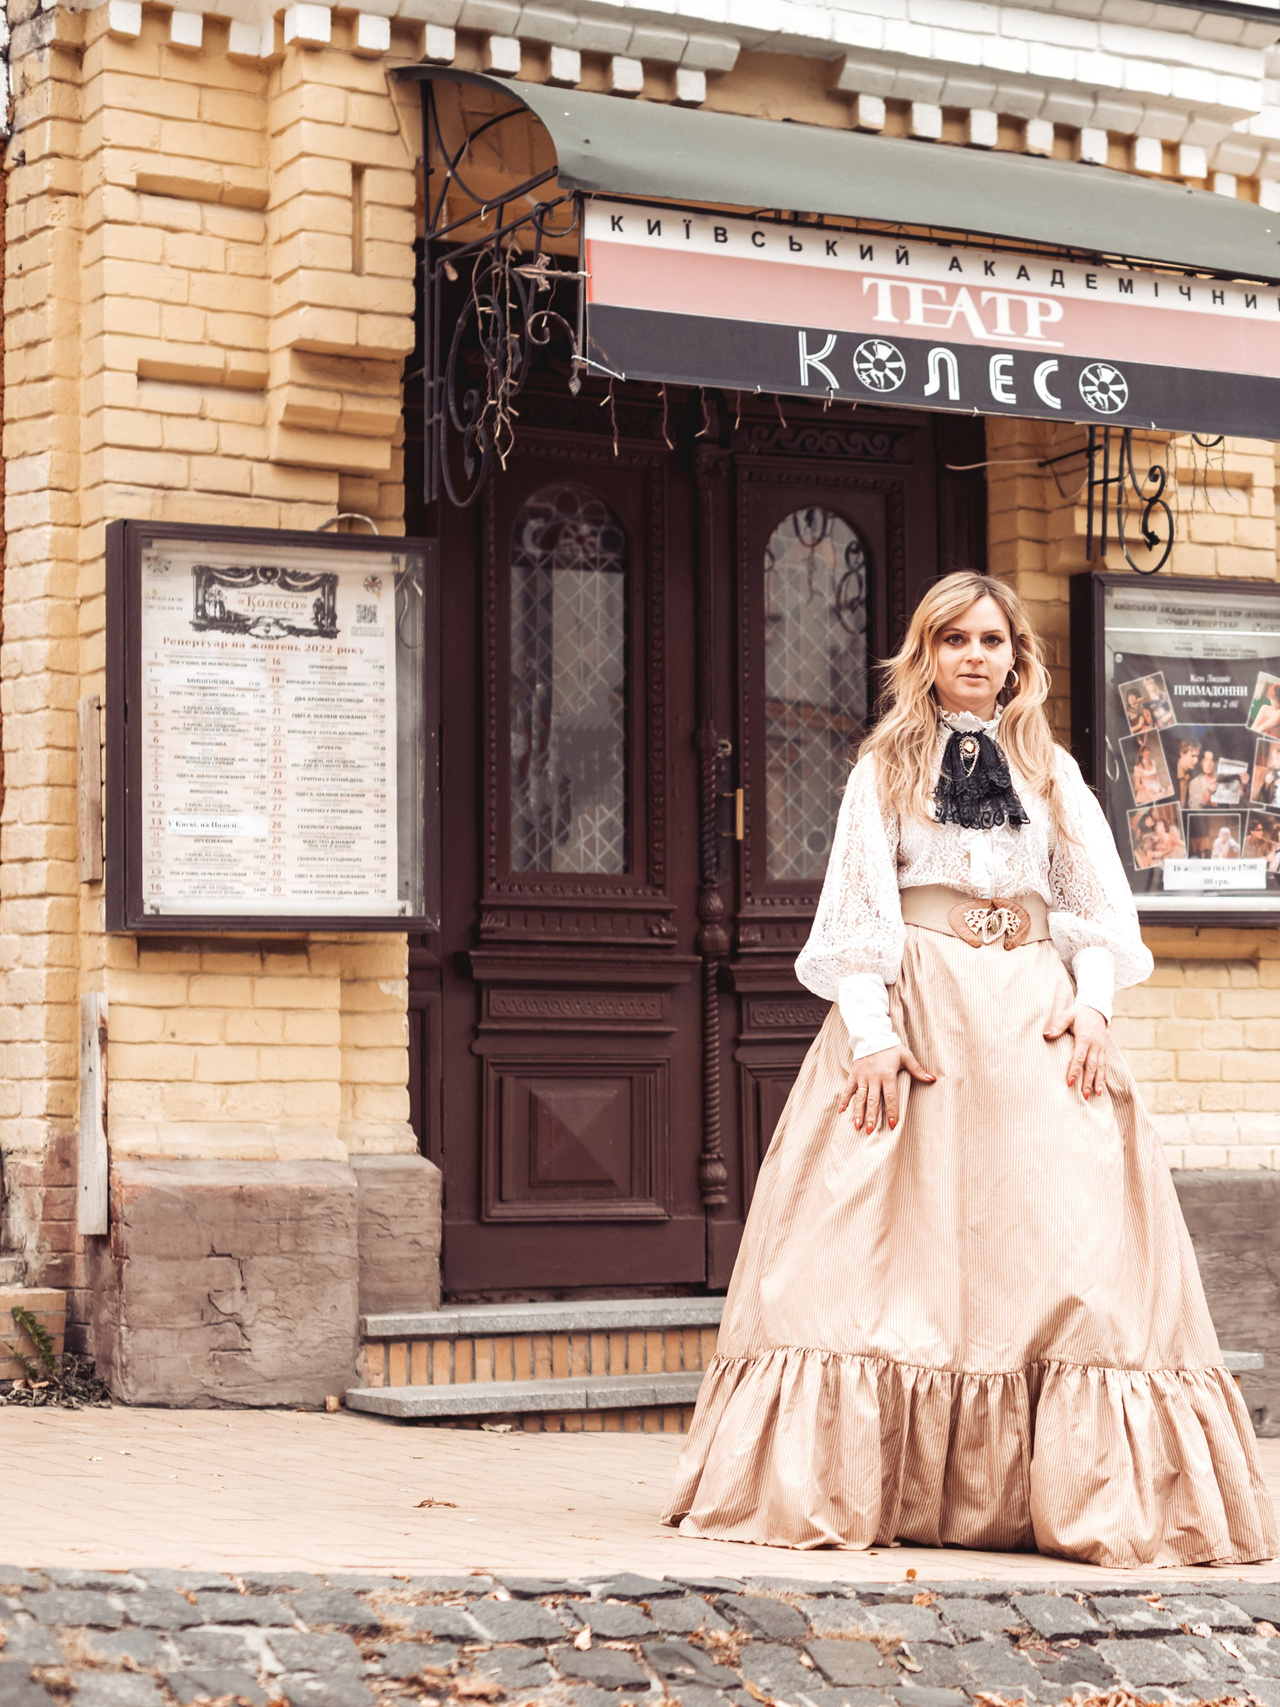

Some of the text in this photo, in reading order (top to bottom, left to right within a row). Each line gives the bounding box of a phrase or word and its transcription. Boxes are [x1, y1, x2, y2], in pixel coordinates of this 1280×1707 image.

[611, 215, 910, 266] КИЇВСЬКИЙ
[862, 277, 1064, 347] ТЕАТР
[238, 596, 306, 609] «Колесо»
[1114, 604, 1158, 612] КИЇВСЬКИЙ
[1160, 606, 1216, 617] АКАДЕМІЧНИЙ
[1218, 610, 1242, 618] ТЕАТР
[1191, 619, 1239, 629] РЕПЕРТУАР
[163, 636, 366, 656] Репертуар на жовтень 2022 року
[186, 678, 235, 686] МИШОЛОВКА
[1190, 674, 1205, 683] Кен
[1174, 685, 1248, 697] ПРИМАДОННИ
[153, 702, 159, 710] 2
[1182, 700, 1210, 708] комедія
[1222, 700, 1228, 709] 2
